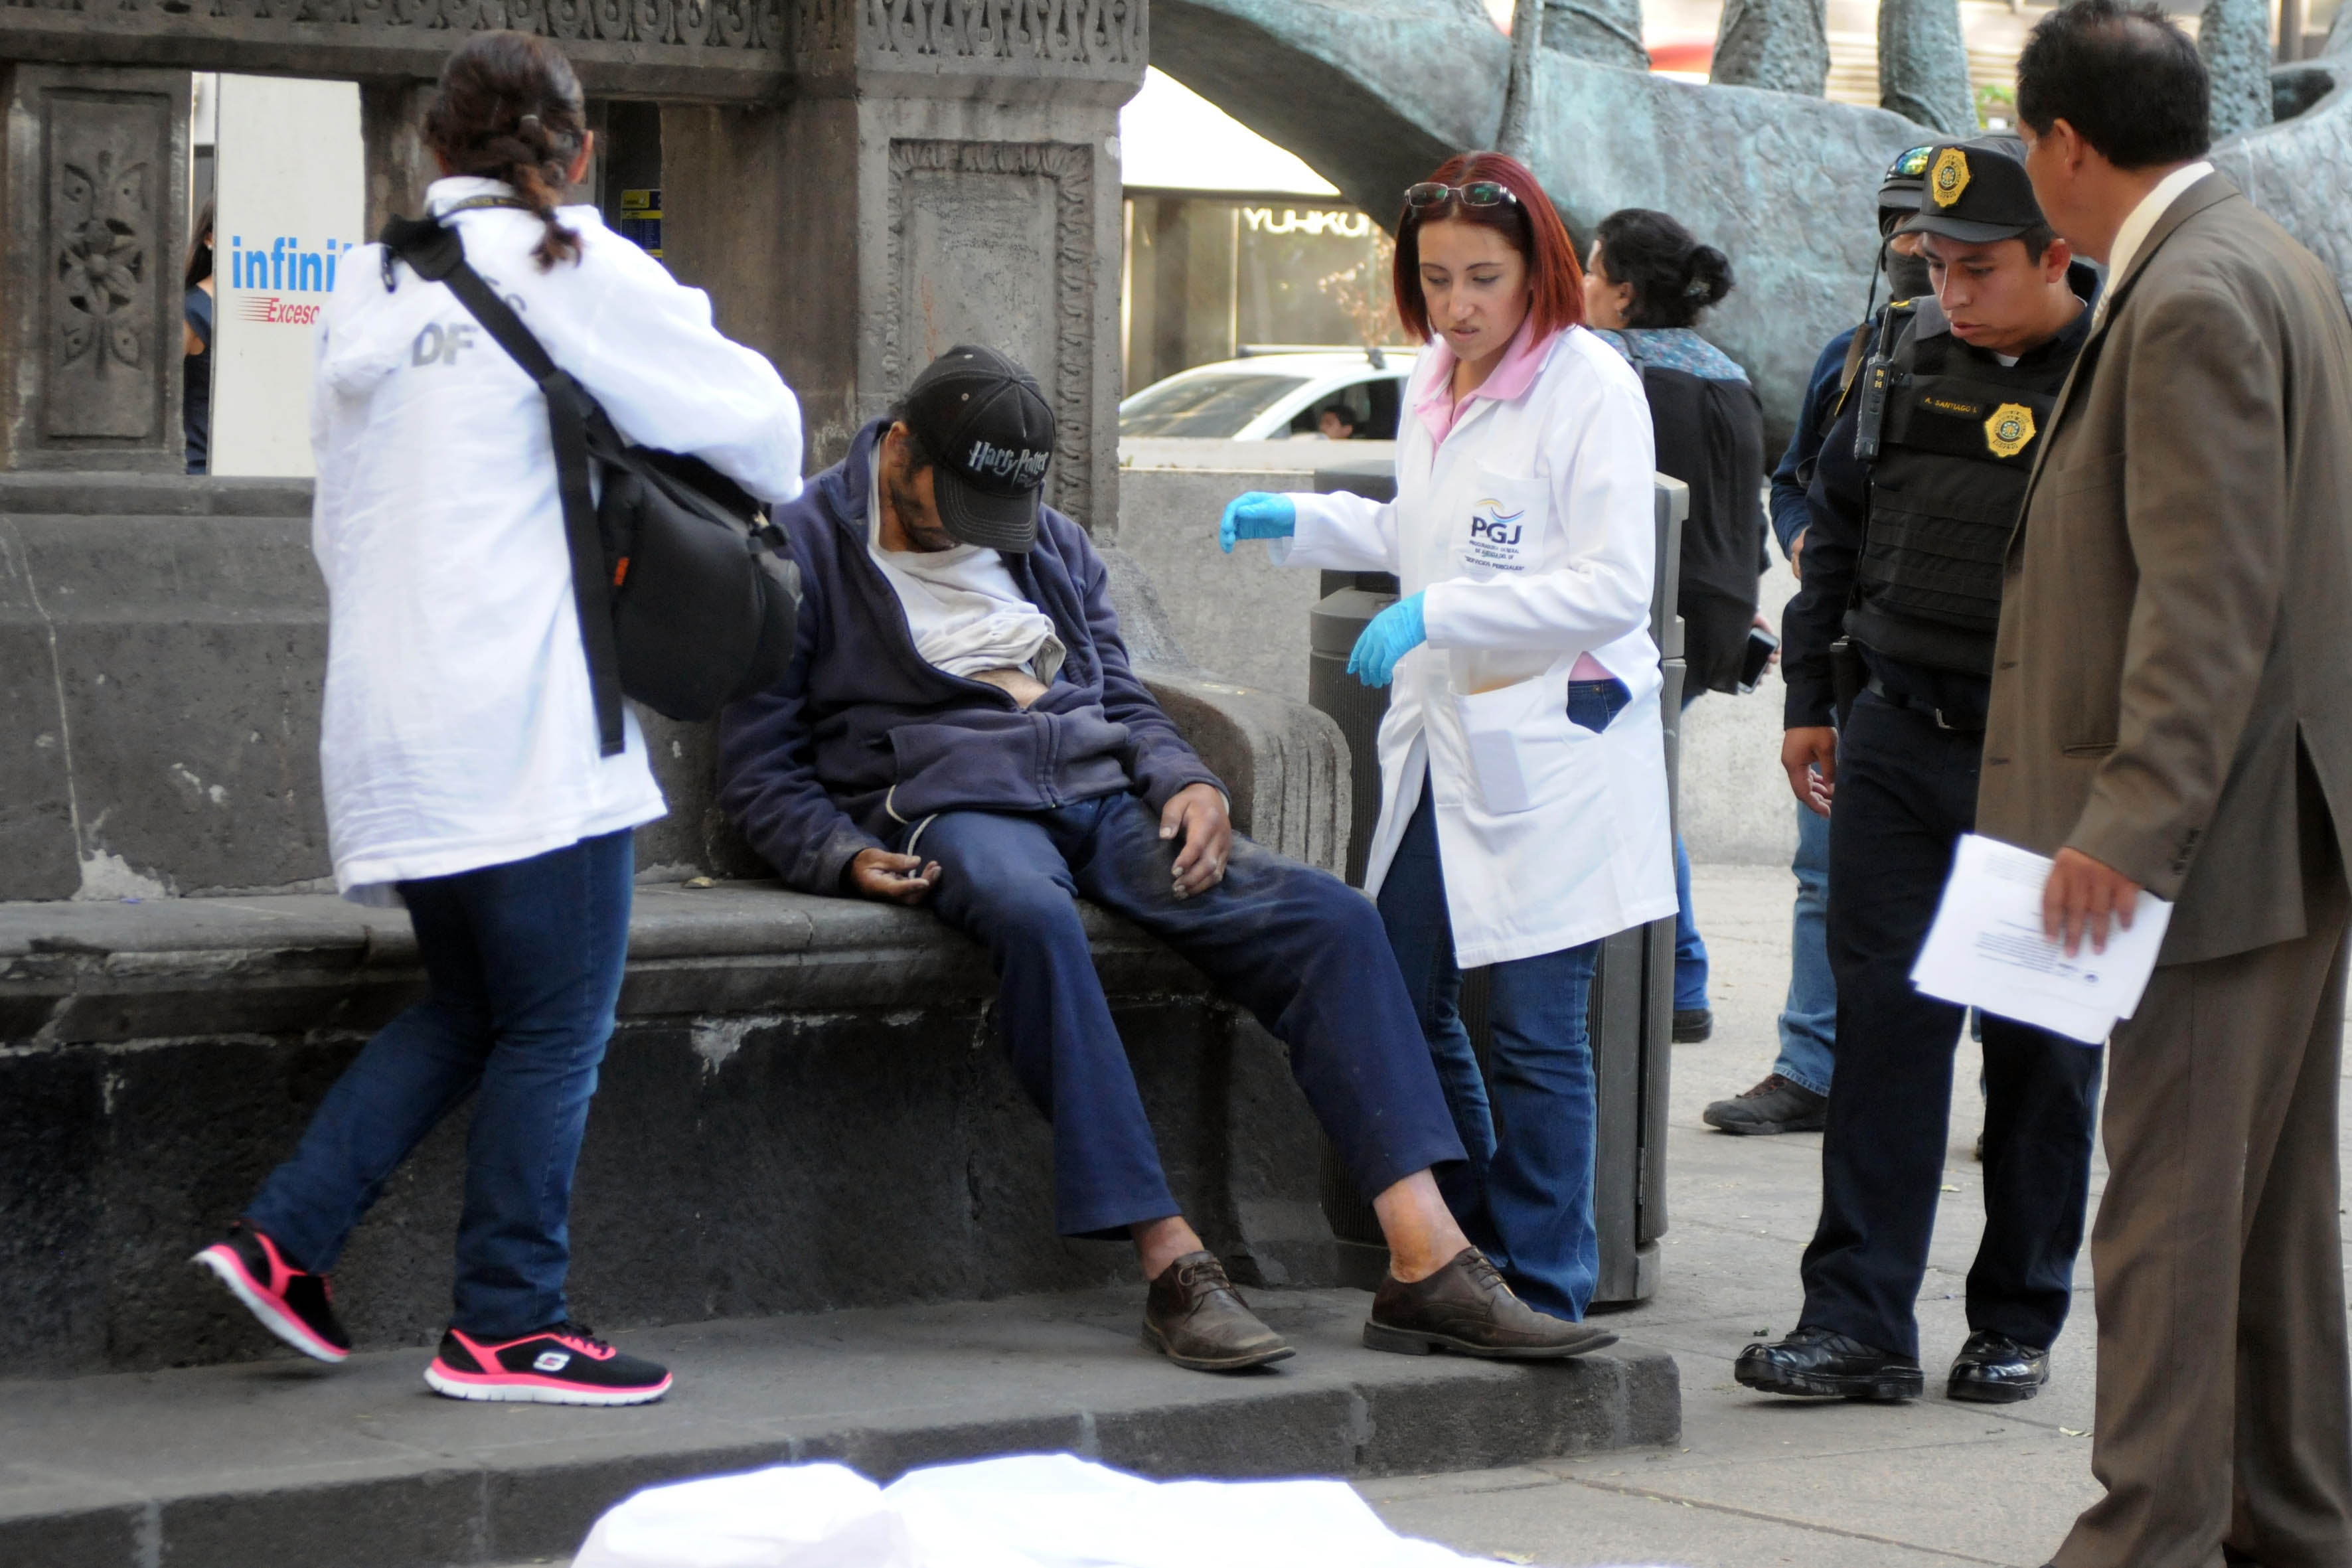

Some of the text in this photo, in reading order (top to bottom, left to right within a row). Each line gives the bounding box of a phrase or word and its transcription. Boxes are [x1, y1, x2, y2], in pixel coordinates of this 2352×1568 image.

[232, 236, 353, 292] infini
[412, 323, 479, 366] DF
[1934, 400, 1971, 412] SANTIAGO
[969, 441, 1019, 476] Harry
[1010, 449, 1049, 488] Potter
[1471, 516, 1523, 545] PGJ
